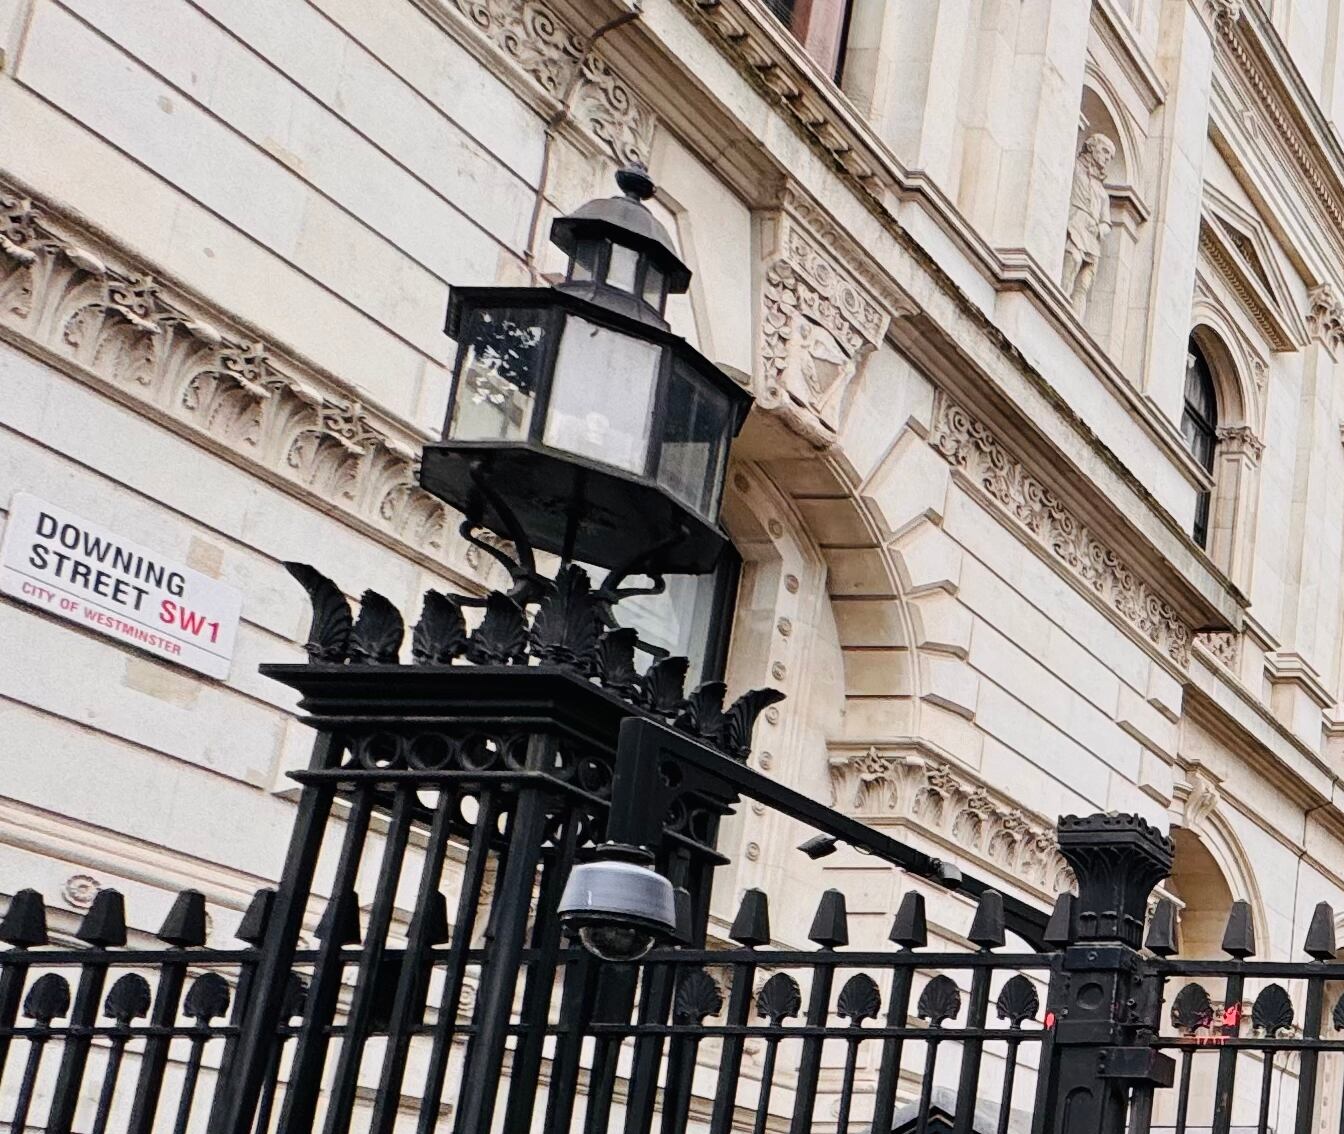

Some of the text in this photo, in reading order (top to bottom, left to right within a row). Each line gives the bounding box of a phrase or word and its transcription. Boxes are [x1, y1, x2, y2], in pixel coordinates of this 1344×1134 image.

[29, 543, 221, 643] STREET SW1
[36, 511, 186, 598] DOWNING
[22, 581, 182, 656] CITY OF WESTMINSTER
